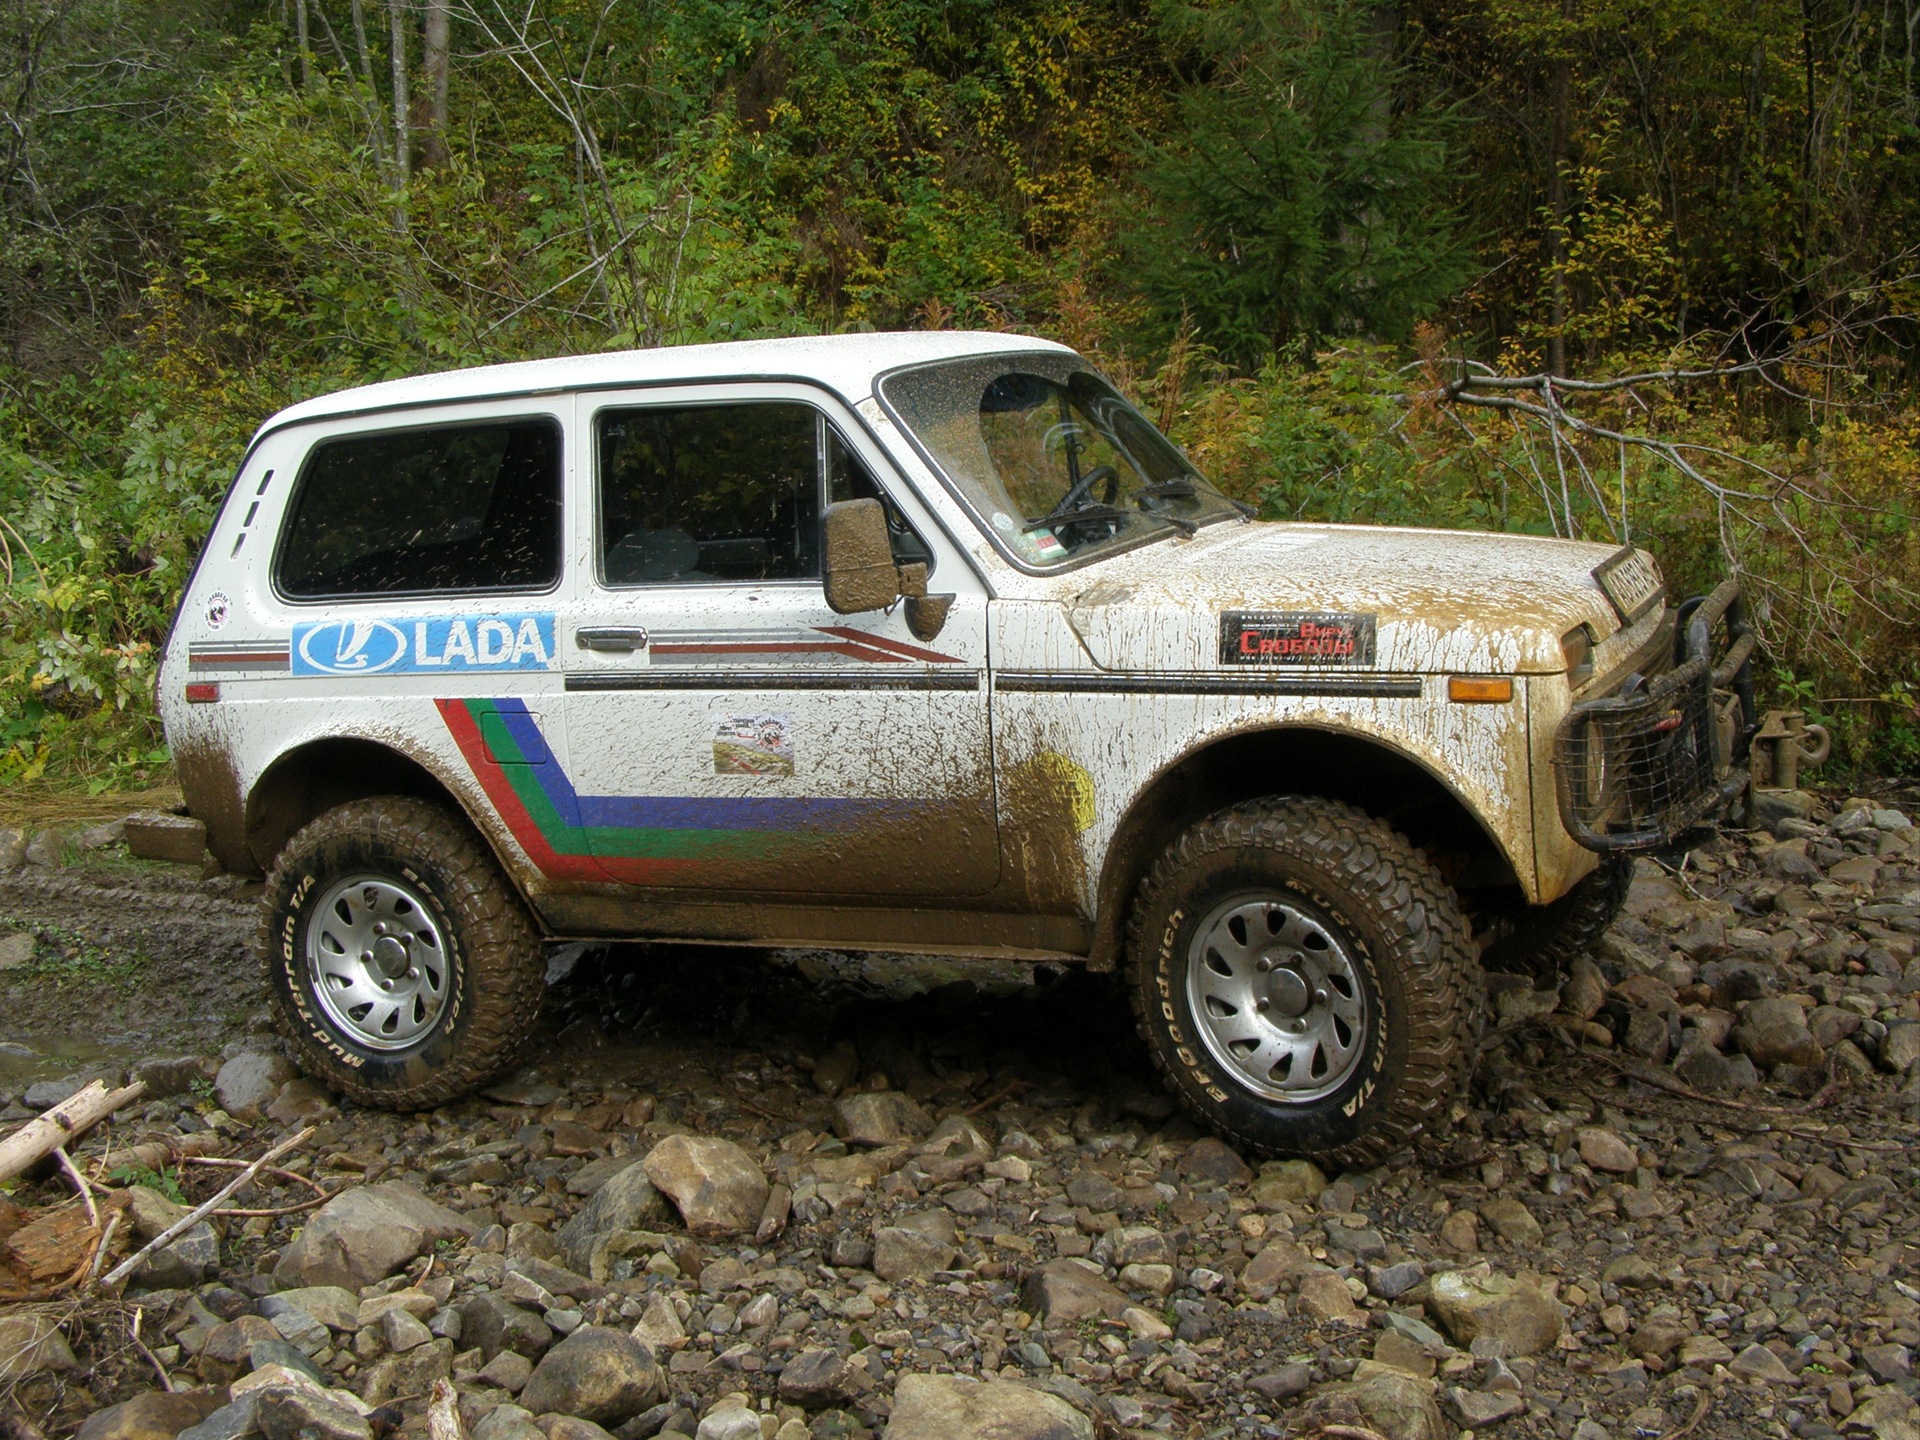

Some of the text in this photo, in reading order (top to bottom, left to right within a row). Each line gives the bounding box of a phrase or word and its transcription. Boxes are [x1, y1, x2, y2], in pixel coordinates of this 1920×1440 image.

[414, 618, 549, 666] LADA
[282, 874, 366, 1069] Mud-Terrain T/A
[1156, 908, 1231, 1103] BFGoodrich
[1342, 1077, 1375, 1117] T/A
